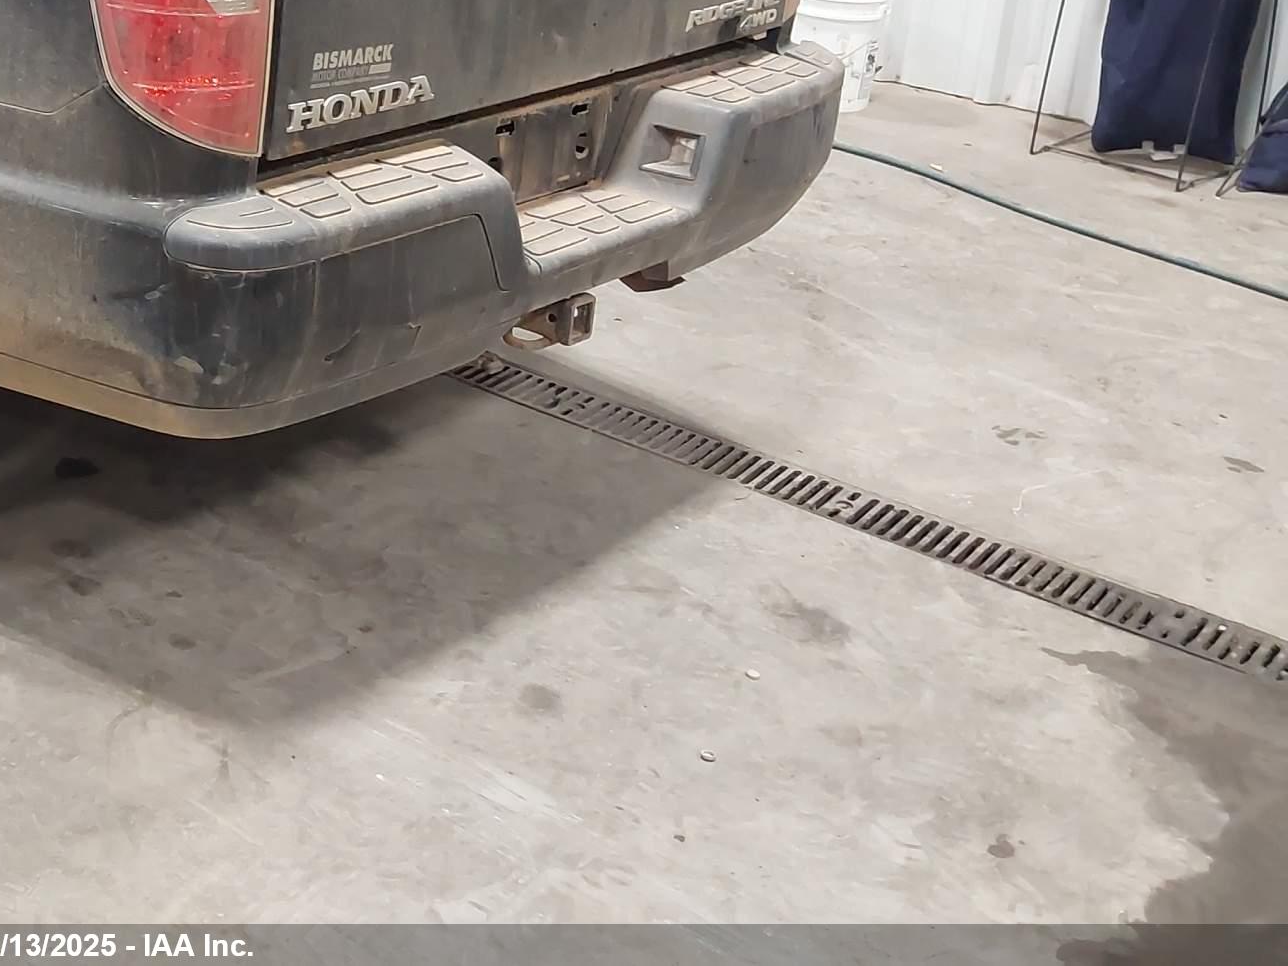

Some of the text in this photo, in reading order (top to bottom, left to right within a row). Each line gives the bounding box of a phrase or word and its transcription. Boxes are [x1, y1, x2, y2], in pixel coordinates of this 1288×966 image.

[739, 8, 778, 30] 4WD
[312, 44, 394, 71] BISMARCK
[286, 75, 435, 133] HONDA
